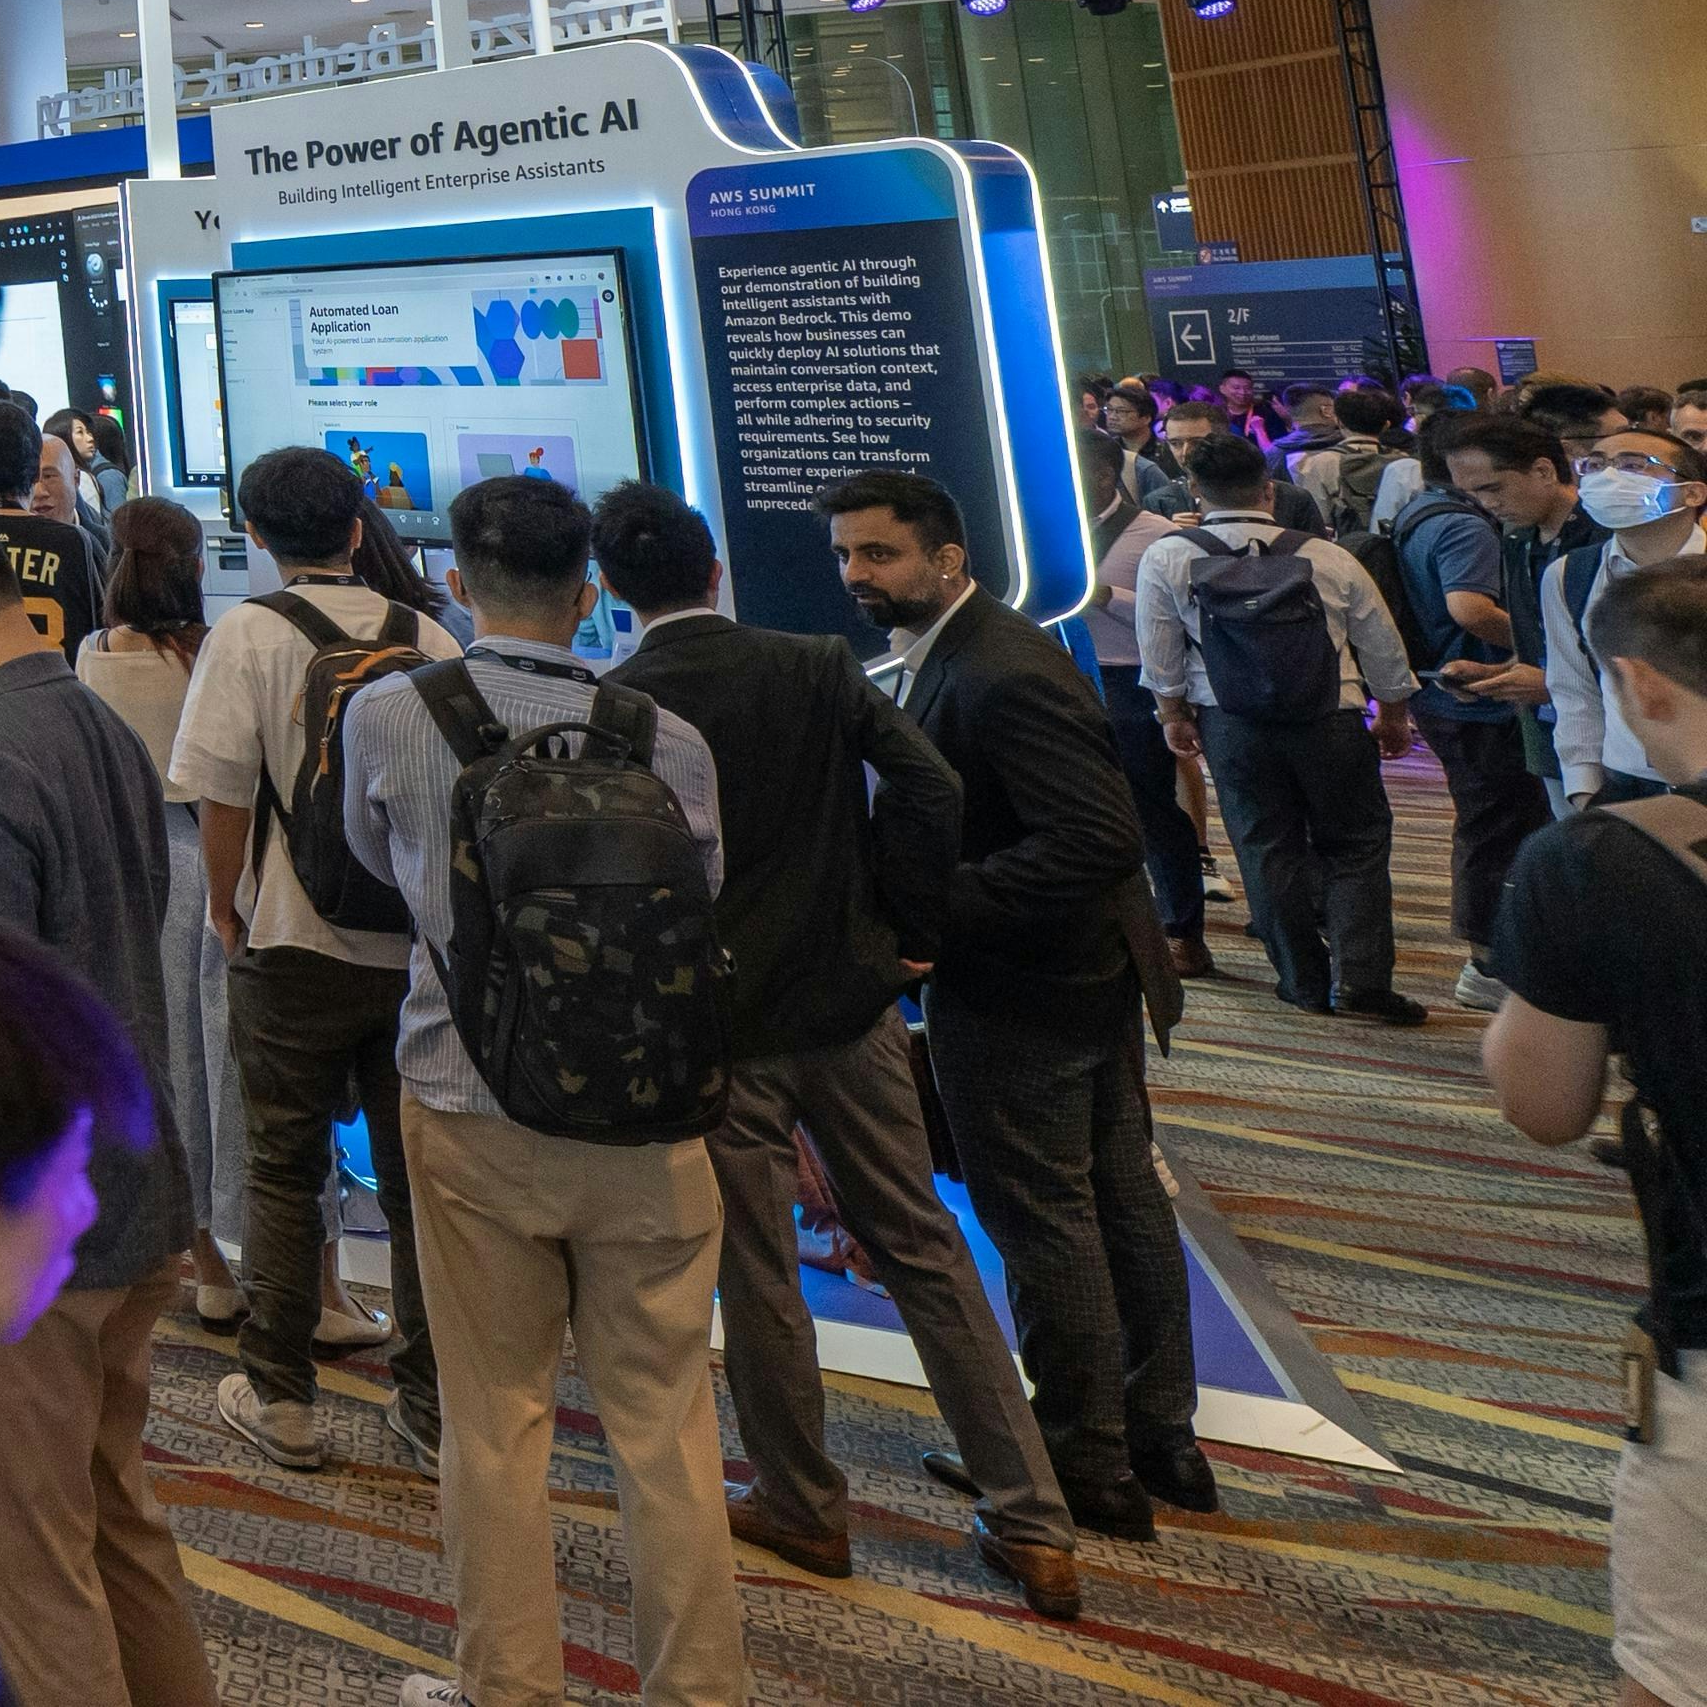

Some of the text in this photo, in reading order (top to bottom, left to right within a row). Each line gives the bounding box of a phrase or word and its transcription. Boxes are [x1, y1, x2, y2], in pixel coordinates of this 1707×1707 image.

[245, 98, 639, 176] The Power of Agentic AI
[278, 157, 605, 206] Building Intelligent Enterprise Assistants
[709, 184, 816, 204] AWS SUMMIT
[711, 205, 776, 218] HONG KONG
[718, 256, 916, 280] Experience agentic AI through
[721, 274, 921, 294] our demonstration of building
[722, 293, 891, 312] intelligent assistants with
[310, 305, 398, 317] Automated Loan
[725, 310, 911, 327] Amazon Bedrock. This demo
[1227, 308, 1250, 325] 2/F
[311, 321, 370, 335] Application
[726, 328, 905, 343] reveals how businesses can
[414, 335, 448, 343] application
[729, 343, 940, 362] quickly deploy AI solutions that
[731, 362, 938, 376] maintain conversation context,
[733, 379, 911, 394] access enterprise data, and
[735, 397, 787, 411] perform
[790, 397, 846, 411] complex
[850, 397, 899, 409] actions
[737, 414, 931, 429] all while adhering to security
[738, 431, 890, 444] requirements. See how
[741, 447, 930, 462] organizations can transform
[743, 465, 867, 479] customer experie
[744, 481, 813, 493] streamline
[7, 547, 60, 586] TER
